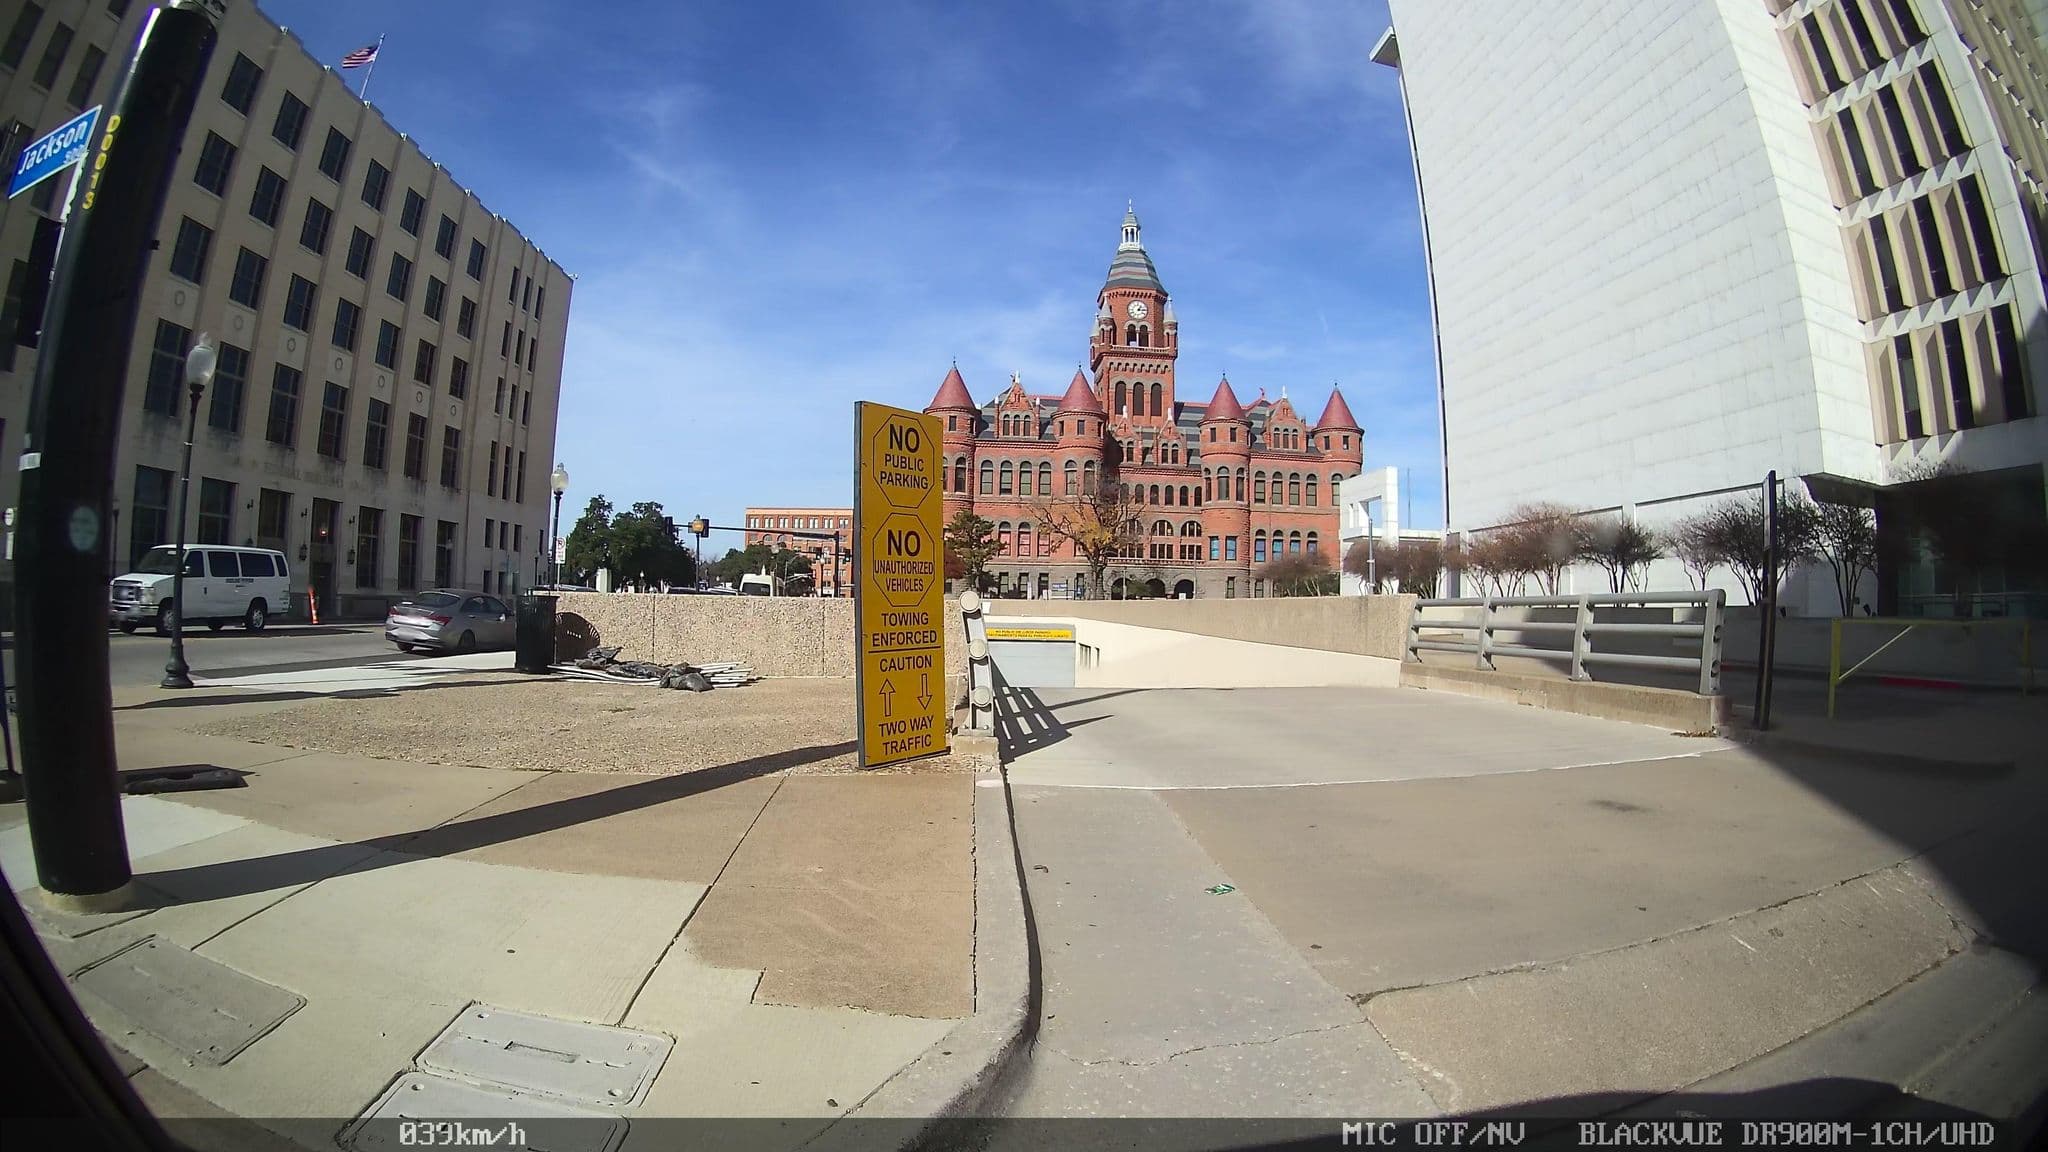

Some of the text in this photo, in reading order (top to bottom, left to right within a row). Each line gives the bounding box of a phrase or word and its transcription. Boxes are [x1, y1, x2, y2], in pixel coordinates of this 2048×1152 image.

[18, 121, 88, 175] Jackson
[889, 423, 920, 453] NO
[884, 453, 924, 472] PUBLIC
[880, 471, 929, 490] PARKING
[887, 529, 921, 557] NO
[874, 559, 934, 575] UNAUTHORIZED
[886, 578, 924, 592] VEHICLES
[881, 612, 929, 627] TOWING
[872, 630, 937, 647] ENFORCED
[879, 655, 932, 672] CAUTION
[878, 715, 934, 737] TWO WAY
[883, 734, 932, 756] TRAFFIC
